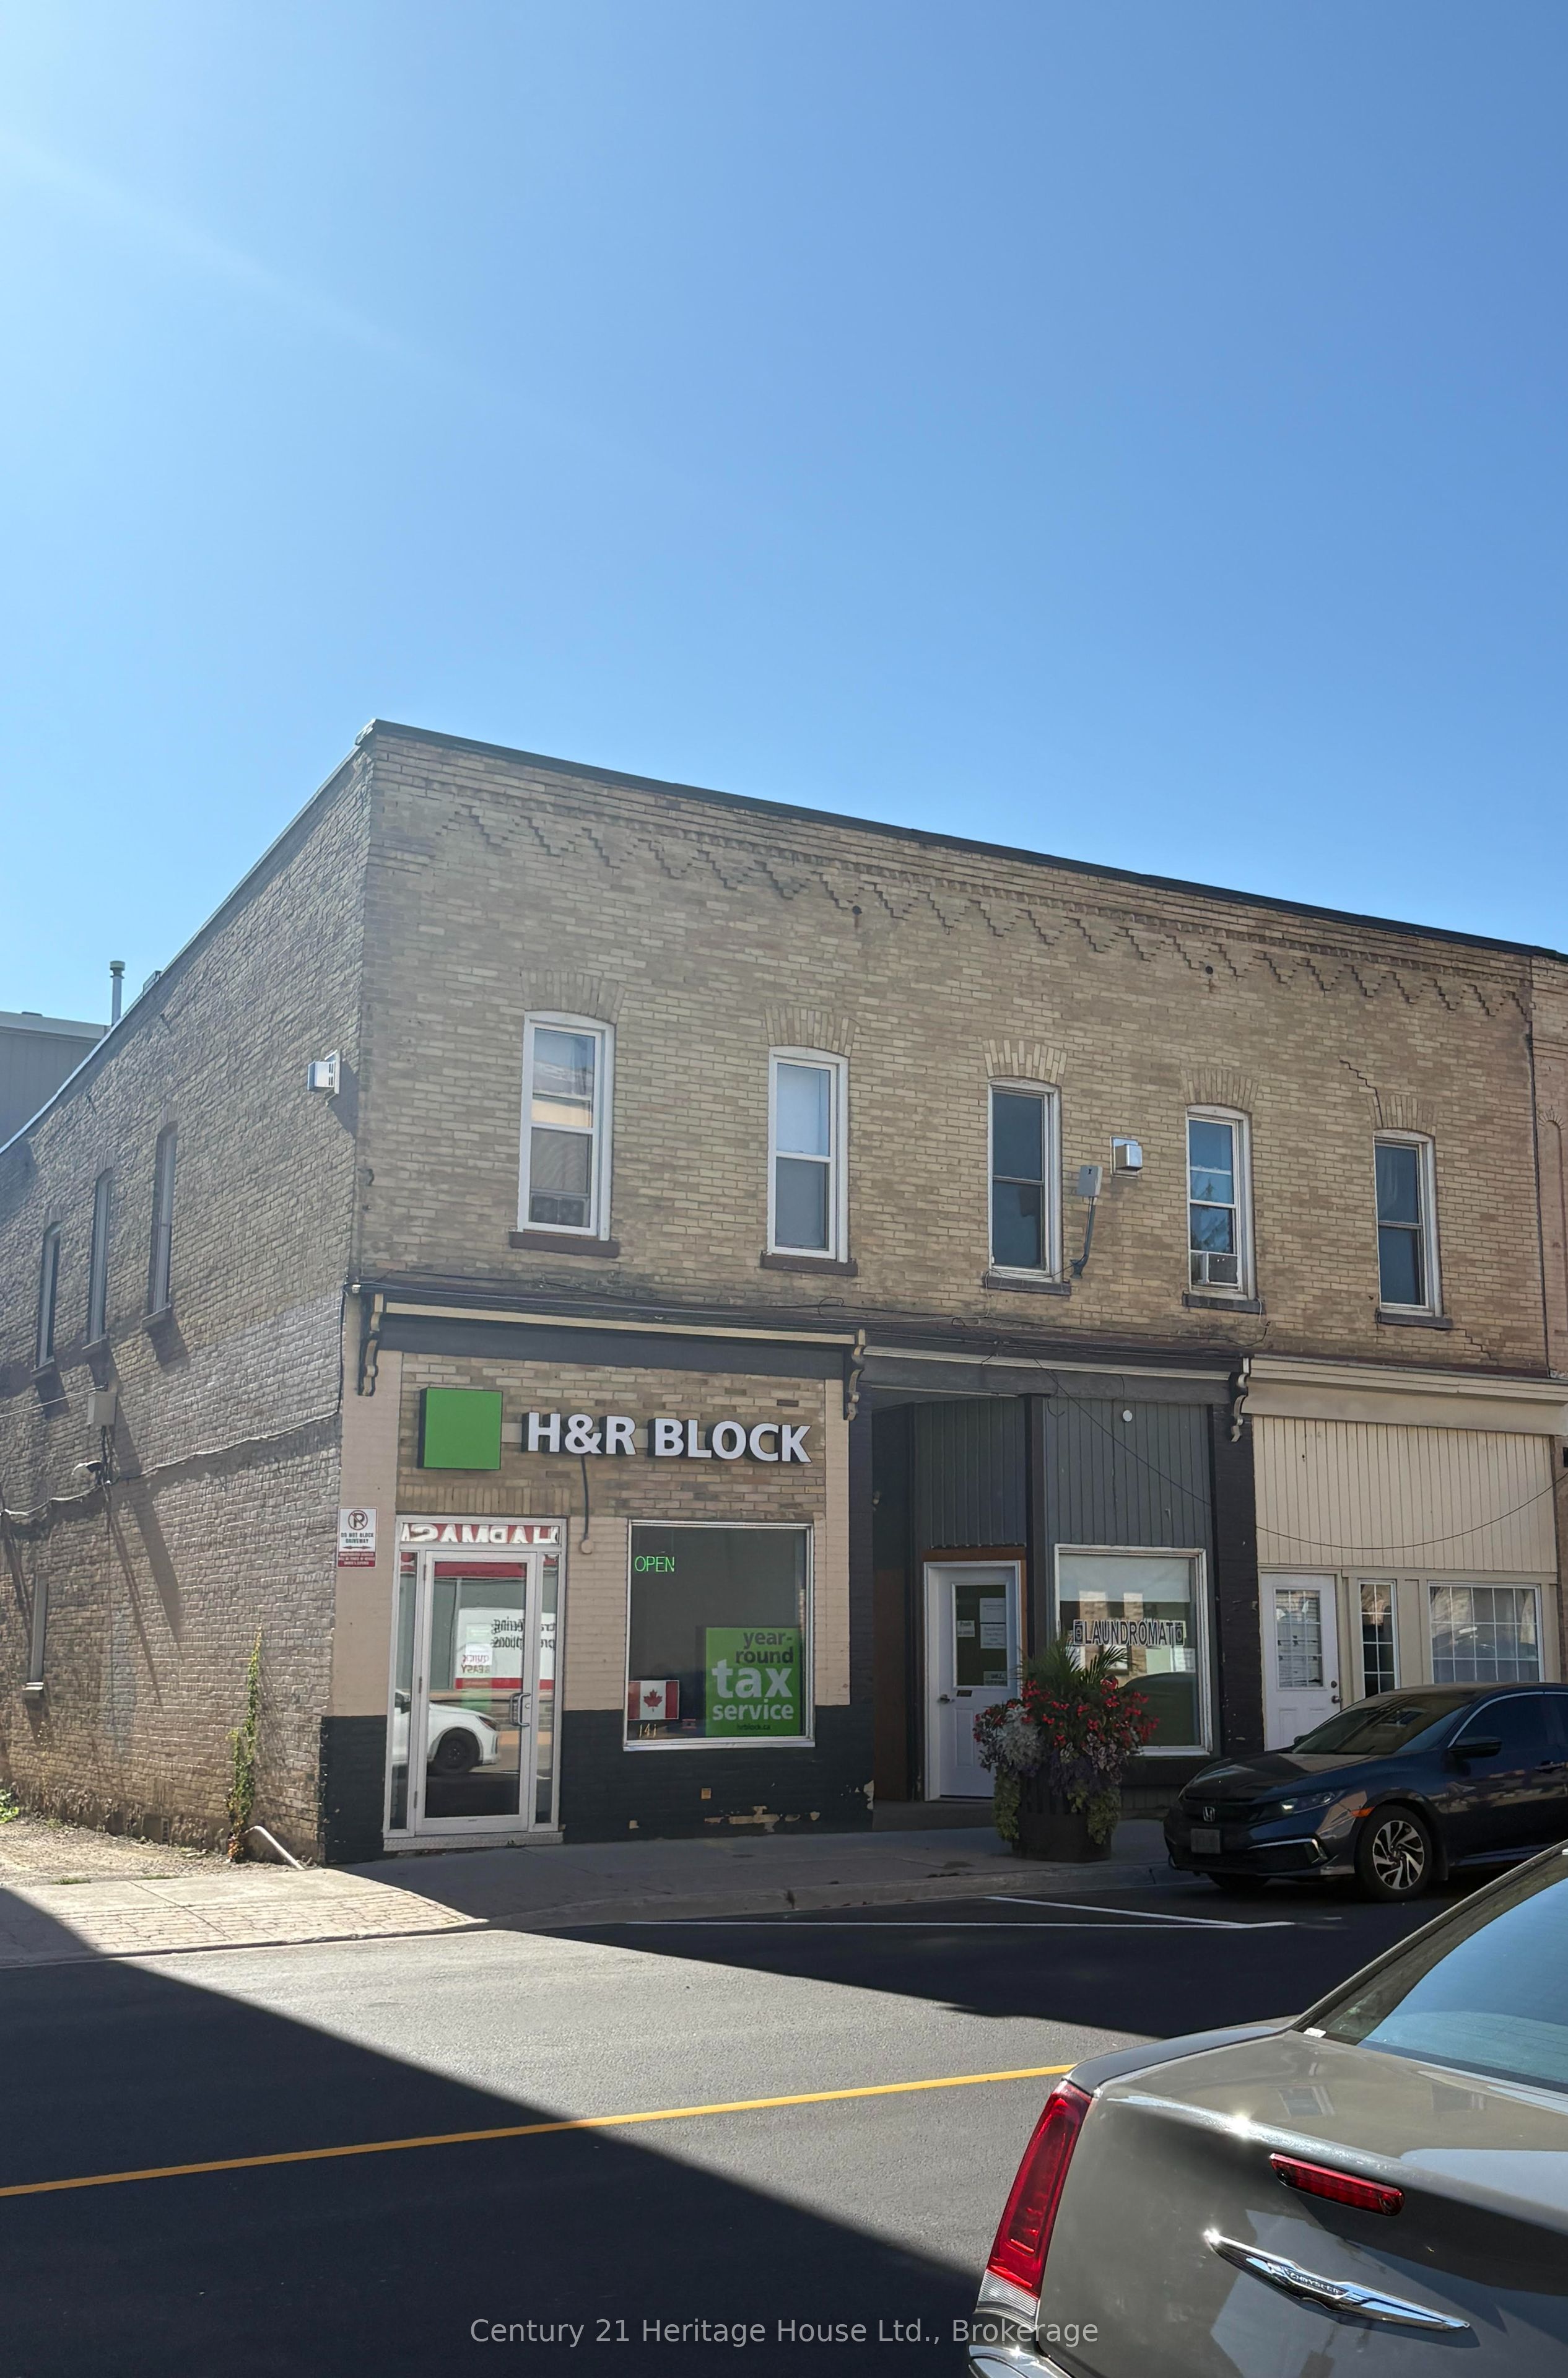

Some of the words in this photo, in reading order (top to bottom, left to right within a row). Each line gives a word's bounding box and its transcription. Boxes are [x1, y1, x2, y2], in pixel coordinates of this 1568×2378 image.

[525, 1411, 637, 1455] H&R
[652, 1418, 812, 1463] BLOCK
[634, 1556, 675, 1572] OPEN
[743, 1631, 792, 1650] year-
[1084, 1620, 1174, 1645] LAUNDROMAT
[735, 1647, 794, 1664] round
[712, 1659, 793, 1699] tax
[712, 1698, 794, 1721] service
